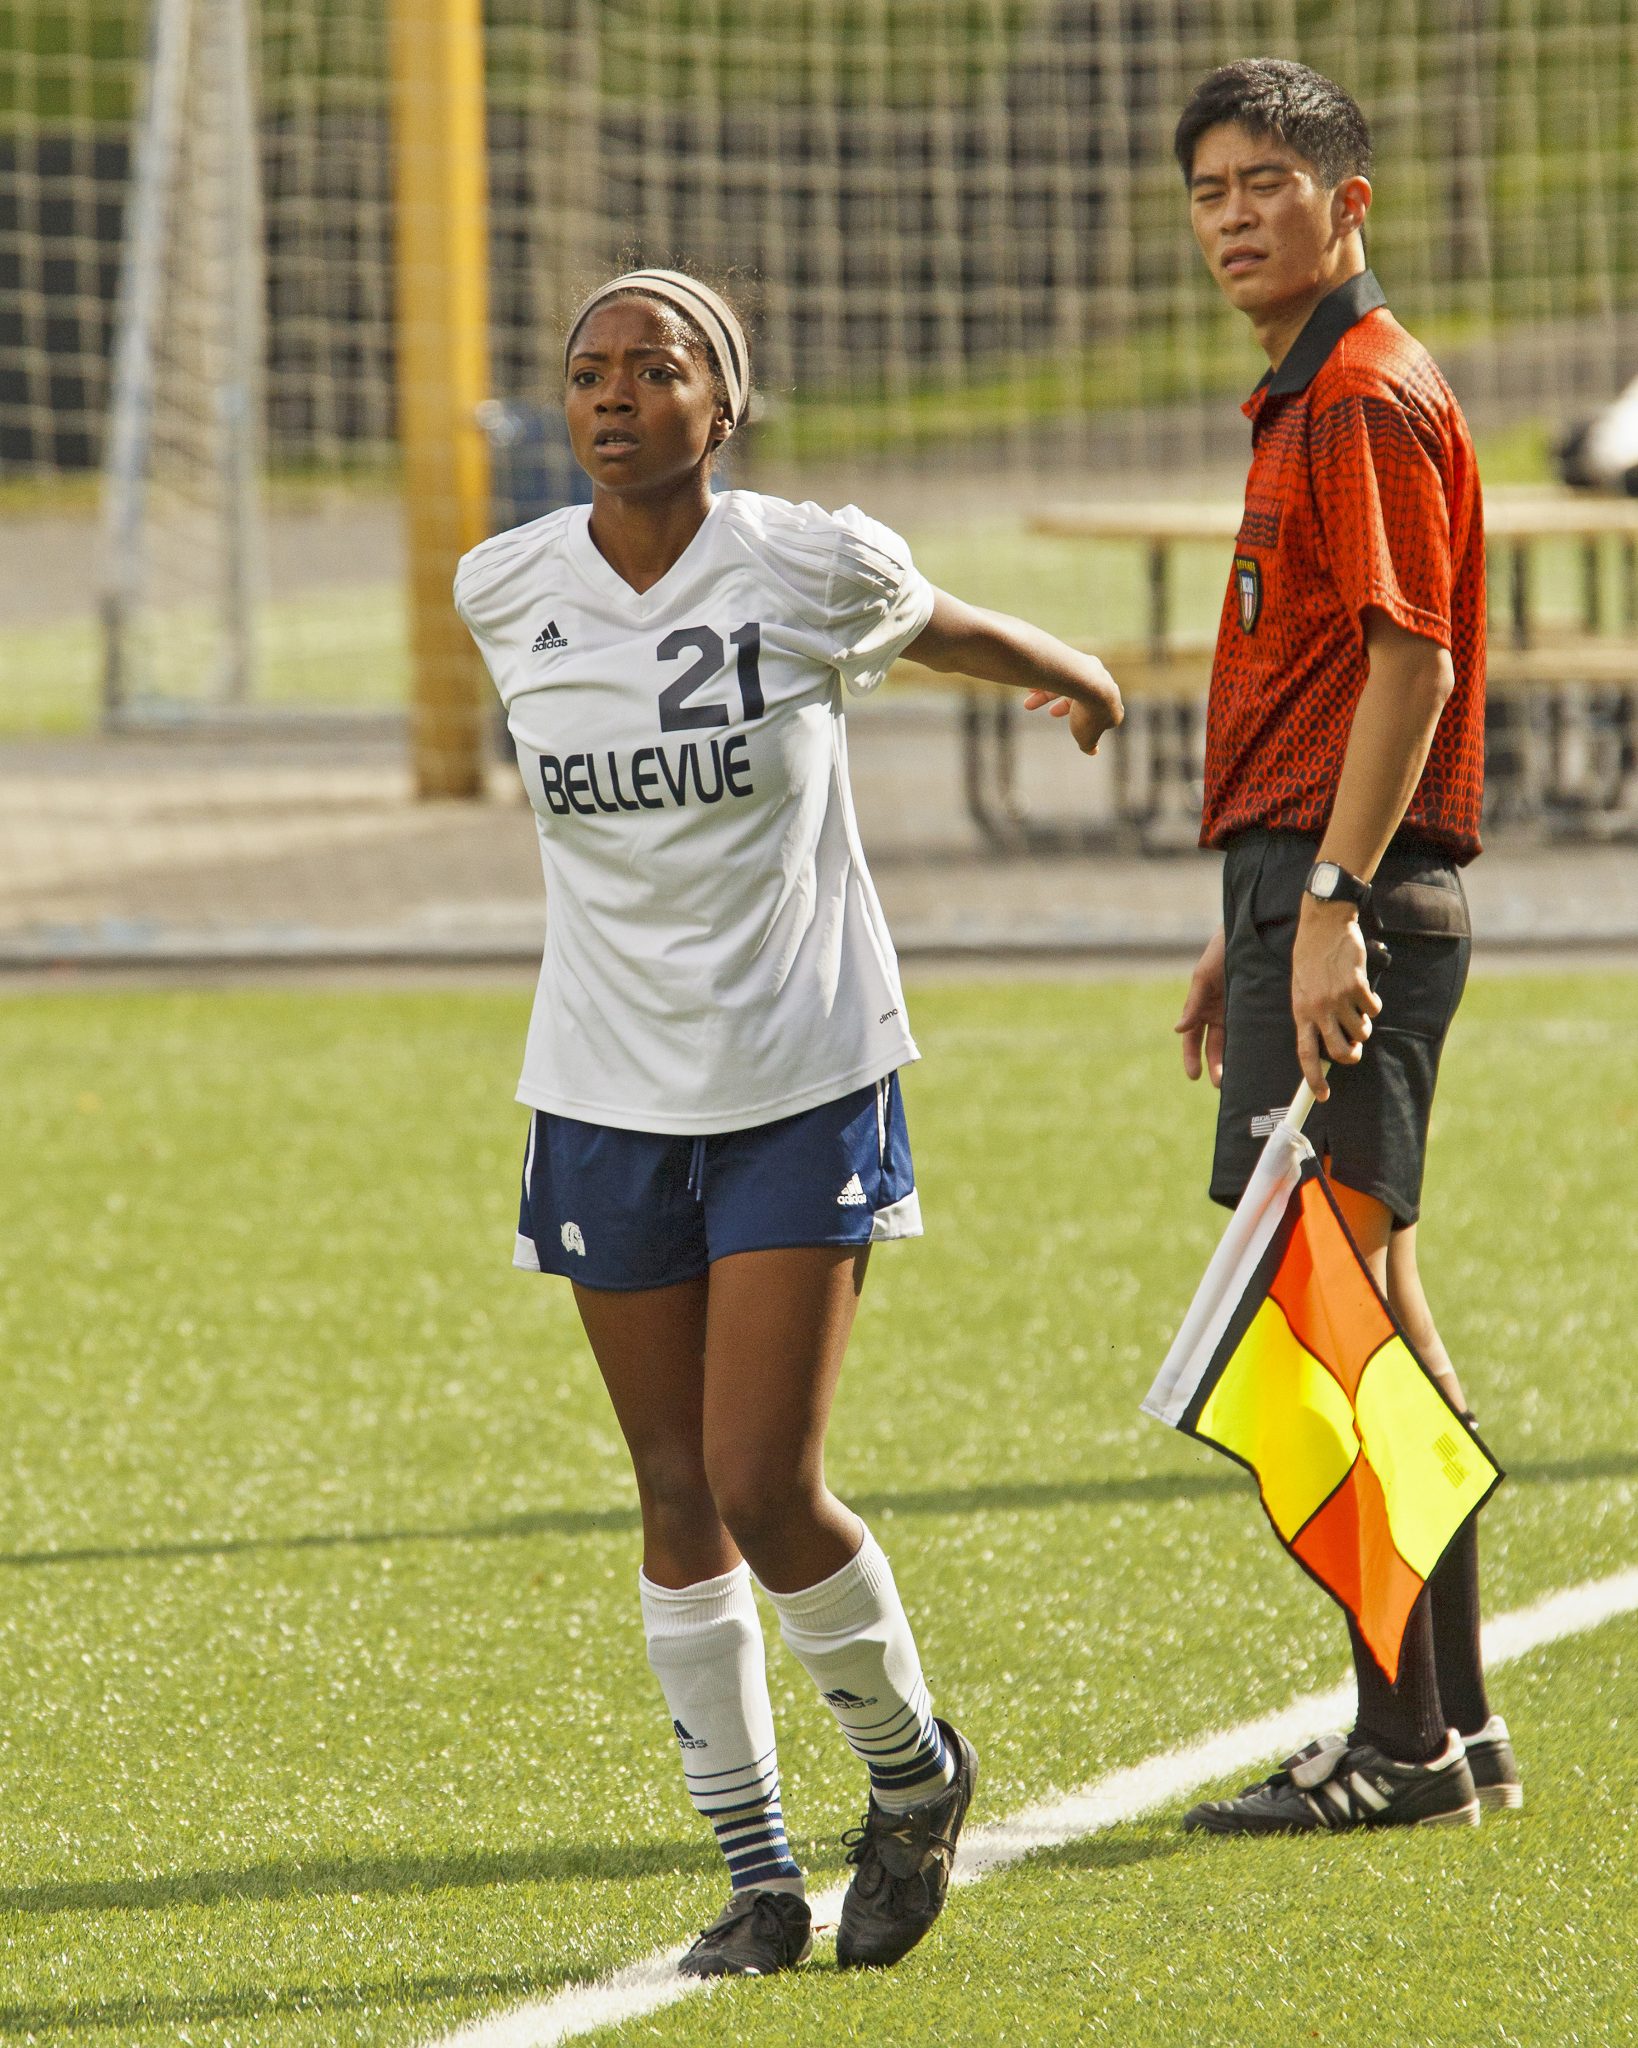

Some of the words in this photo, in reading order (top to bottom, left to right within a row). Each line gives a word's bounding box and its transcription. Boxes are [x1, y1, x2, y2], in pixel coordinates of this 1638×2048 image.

[532, 638, 568, 653] adidas
[656, 622, 765, 733] 21
[539, 734, 754, 815] BELLEVUE
